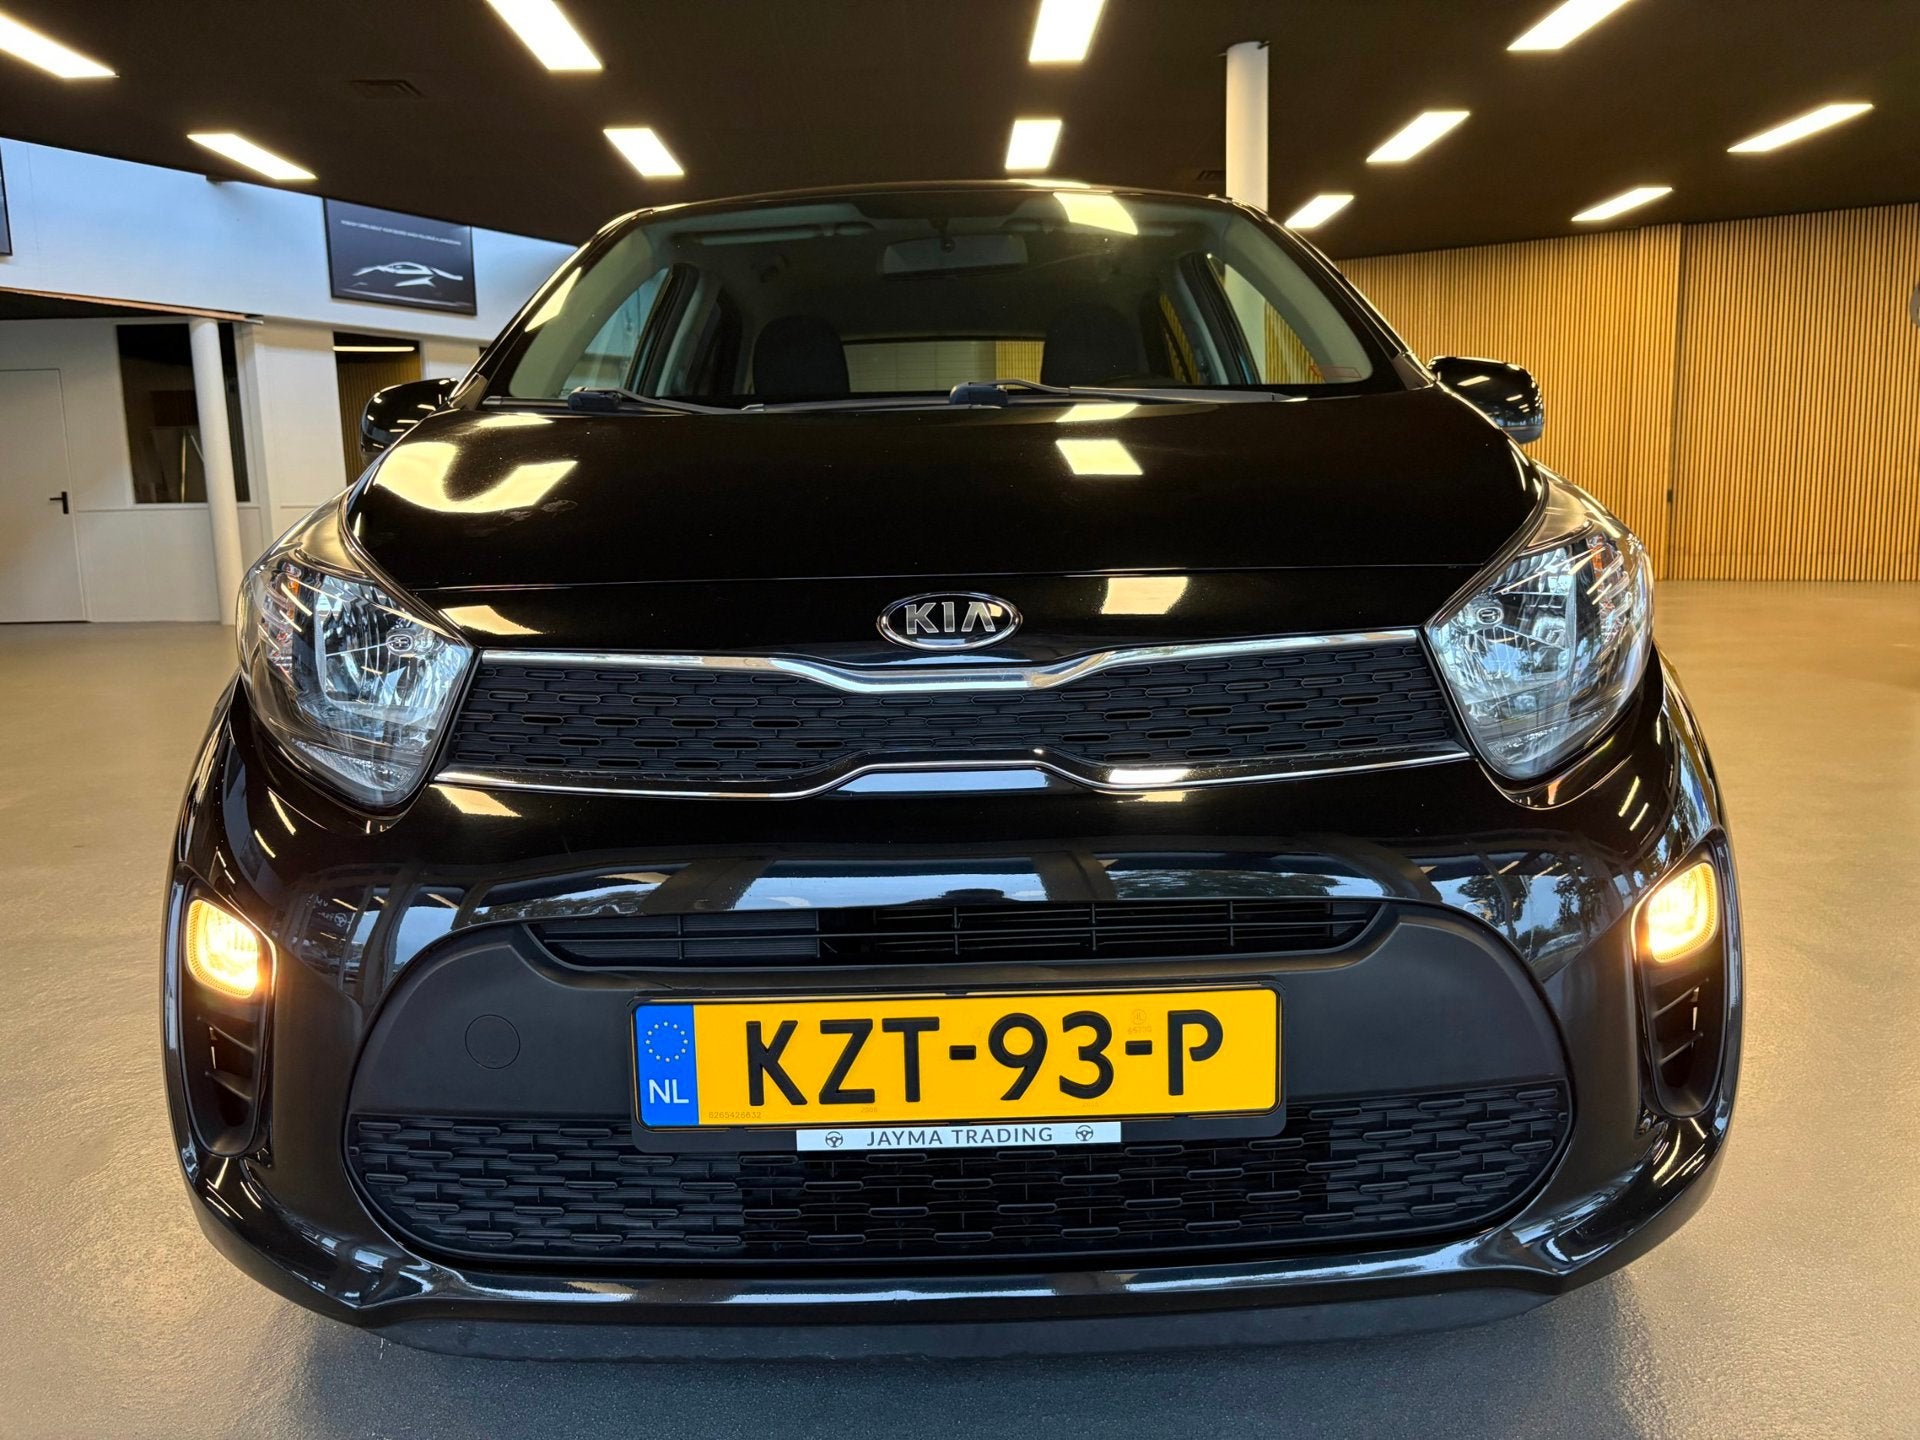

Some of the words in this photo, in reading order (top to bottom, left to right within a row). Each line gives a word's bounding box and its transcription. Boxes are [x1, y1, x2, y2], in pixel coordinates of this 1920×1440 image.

[904, 601, 996, 635] KIA
[746, 1010, 1224, 1106] KZT-93-P
[648, 1079, 690, 1106] NL
[866, 1130, 943, 1147] JAYMA
[951, 1126, 1054, 1145] TRADING
